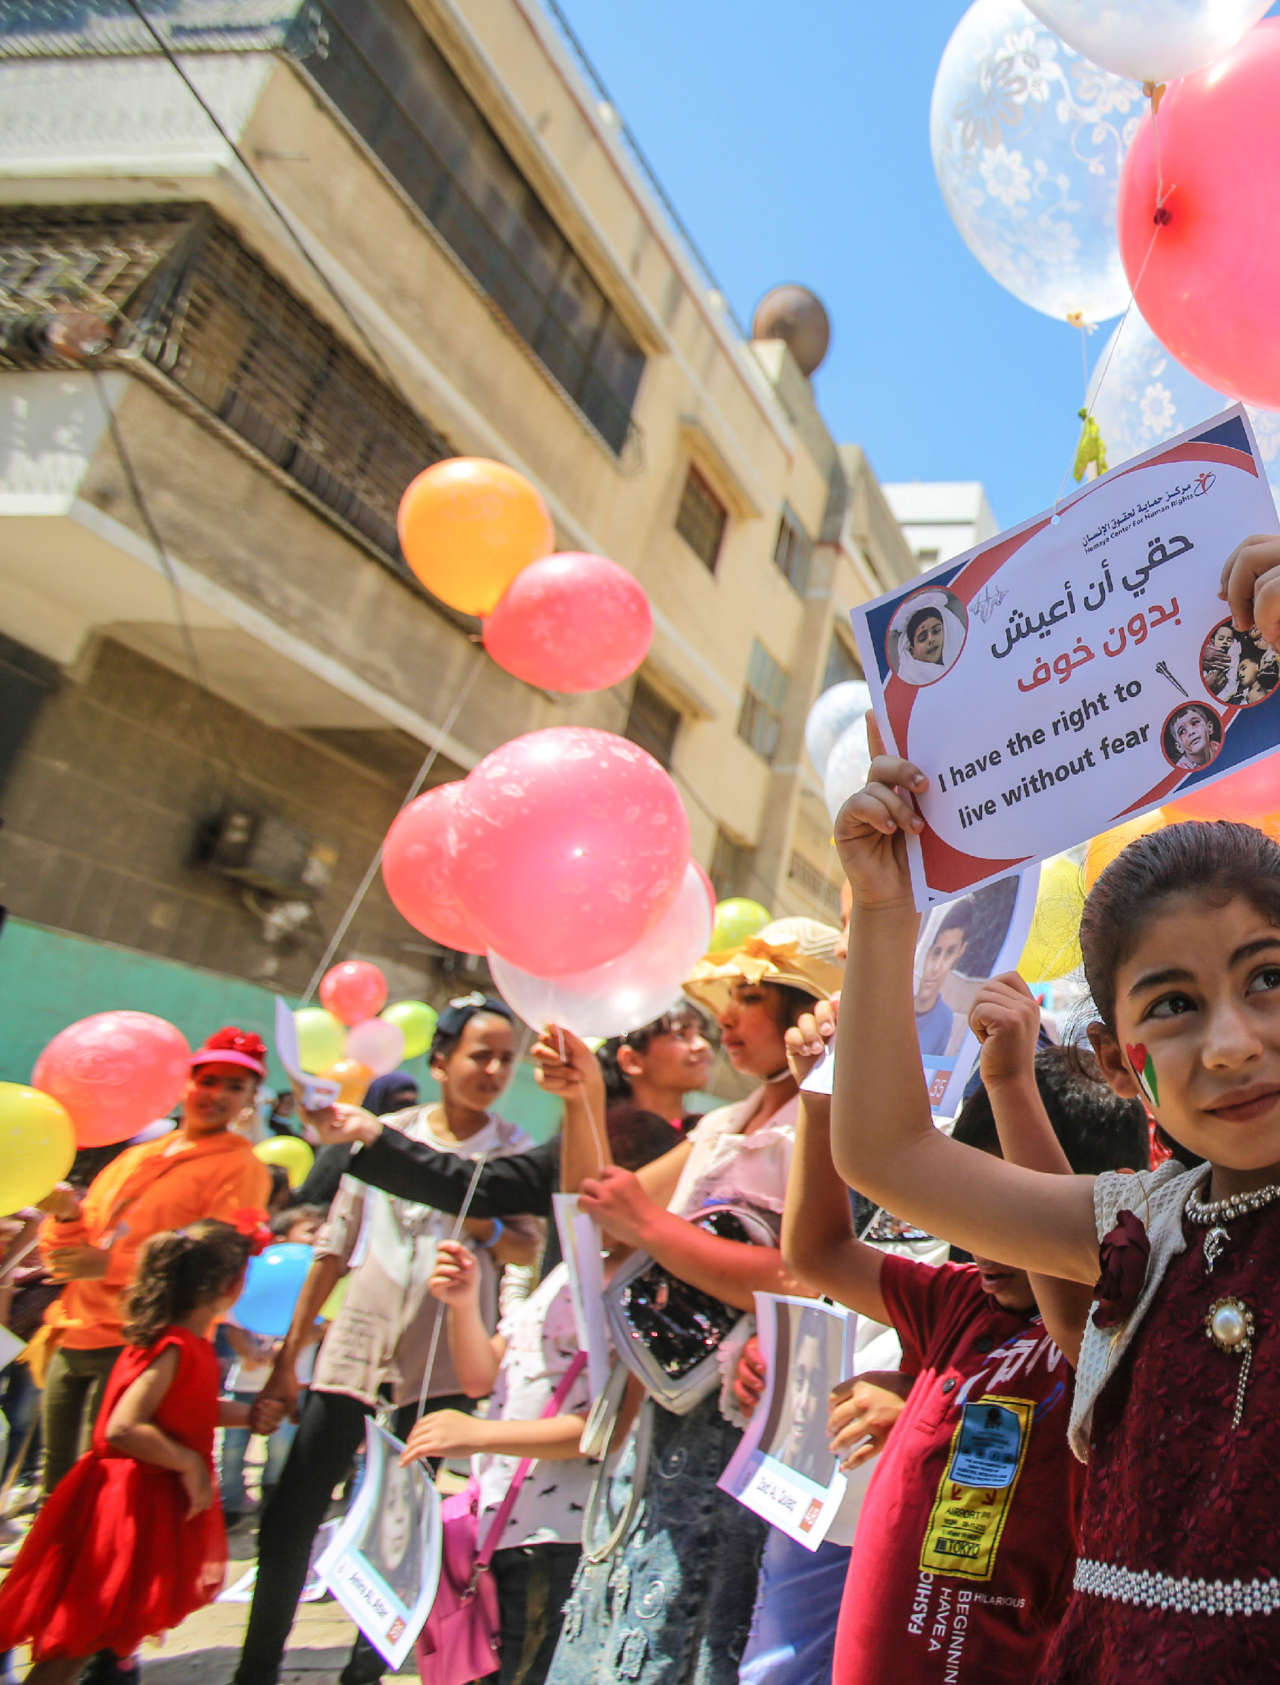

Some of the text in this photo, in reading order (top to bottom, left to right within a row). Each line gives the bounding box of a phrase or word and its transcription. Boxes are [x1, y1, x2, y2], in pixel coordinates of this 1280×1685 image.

[1110, 523, 1132, 539] Center
[1132, 516, 1145, 528] For
[1144, 504, 1170, 520] Human
[1170, 493, 1195, 508] Rights
[1083, 558, 1114, 611] أن
[1121, 534, 1195, 598] حقي
[991, 580, 1076, 659] أعيش
[1017, 597, 1181, 692] بدون خوف
[937, 679, 1143, 793] I have the right to
[958, 723, 1151, 830] live without fear
[928, 1587, 953, 1652] HAVE A
[943, 1590, 972, 1685] BEGINNIN
